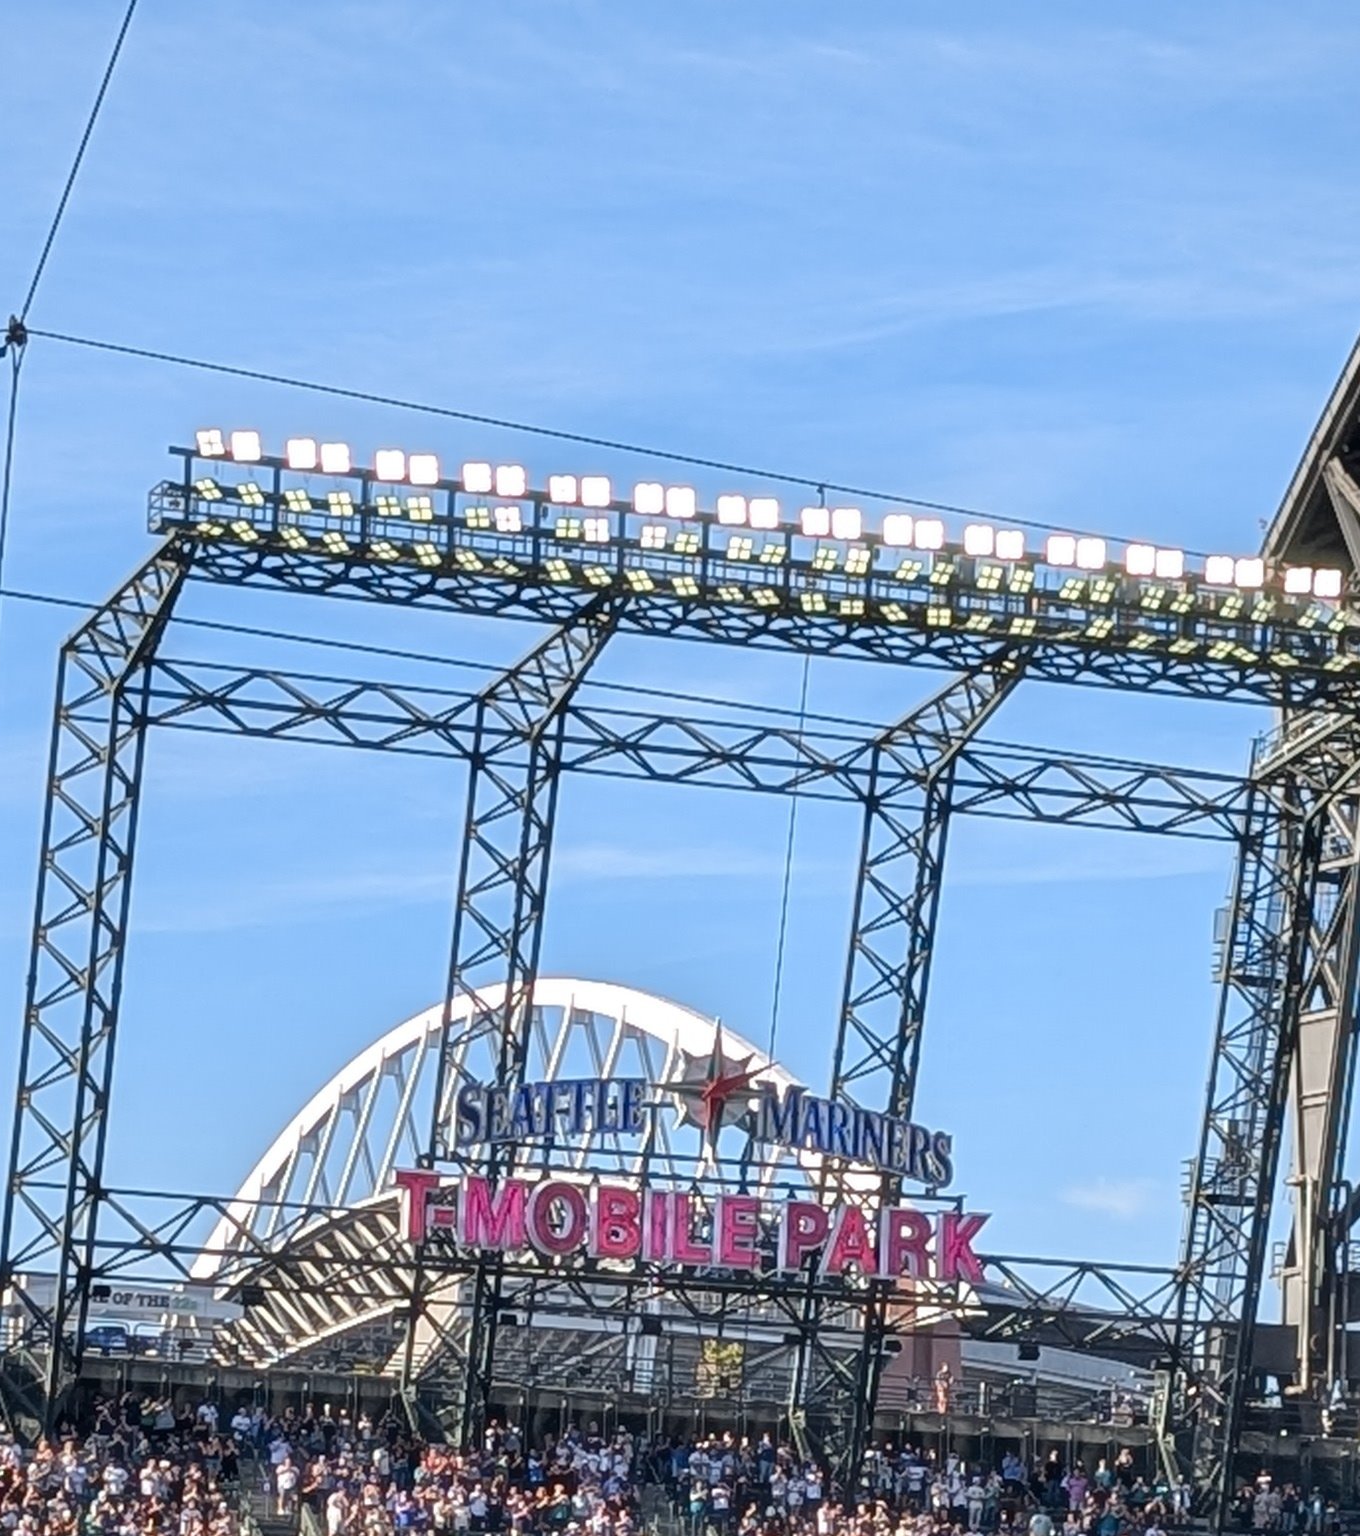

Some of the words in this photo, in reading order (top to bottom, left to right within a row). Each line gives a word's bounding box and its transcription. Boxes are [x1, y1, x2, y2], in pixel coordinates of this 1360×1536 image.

[454, 1078, 646, 1147] SEATTLE
[757, 1081, 953, 1189] MARINERS
[395, 1168, 761, 1270] T-MOBILE
[779, 1199, 991, 1283] PARK
[113, 1292, 134, 1305] OF
[136, 1294, 170, 1308] THE
